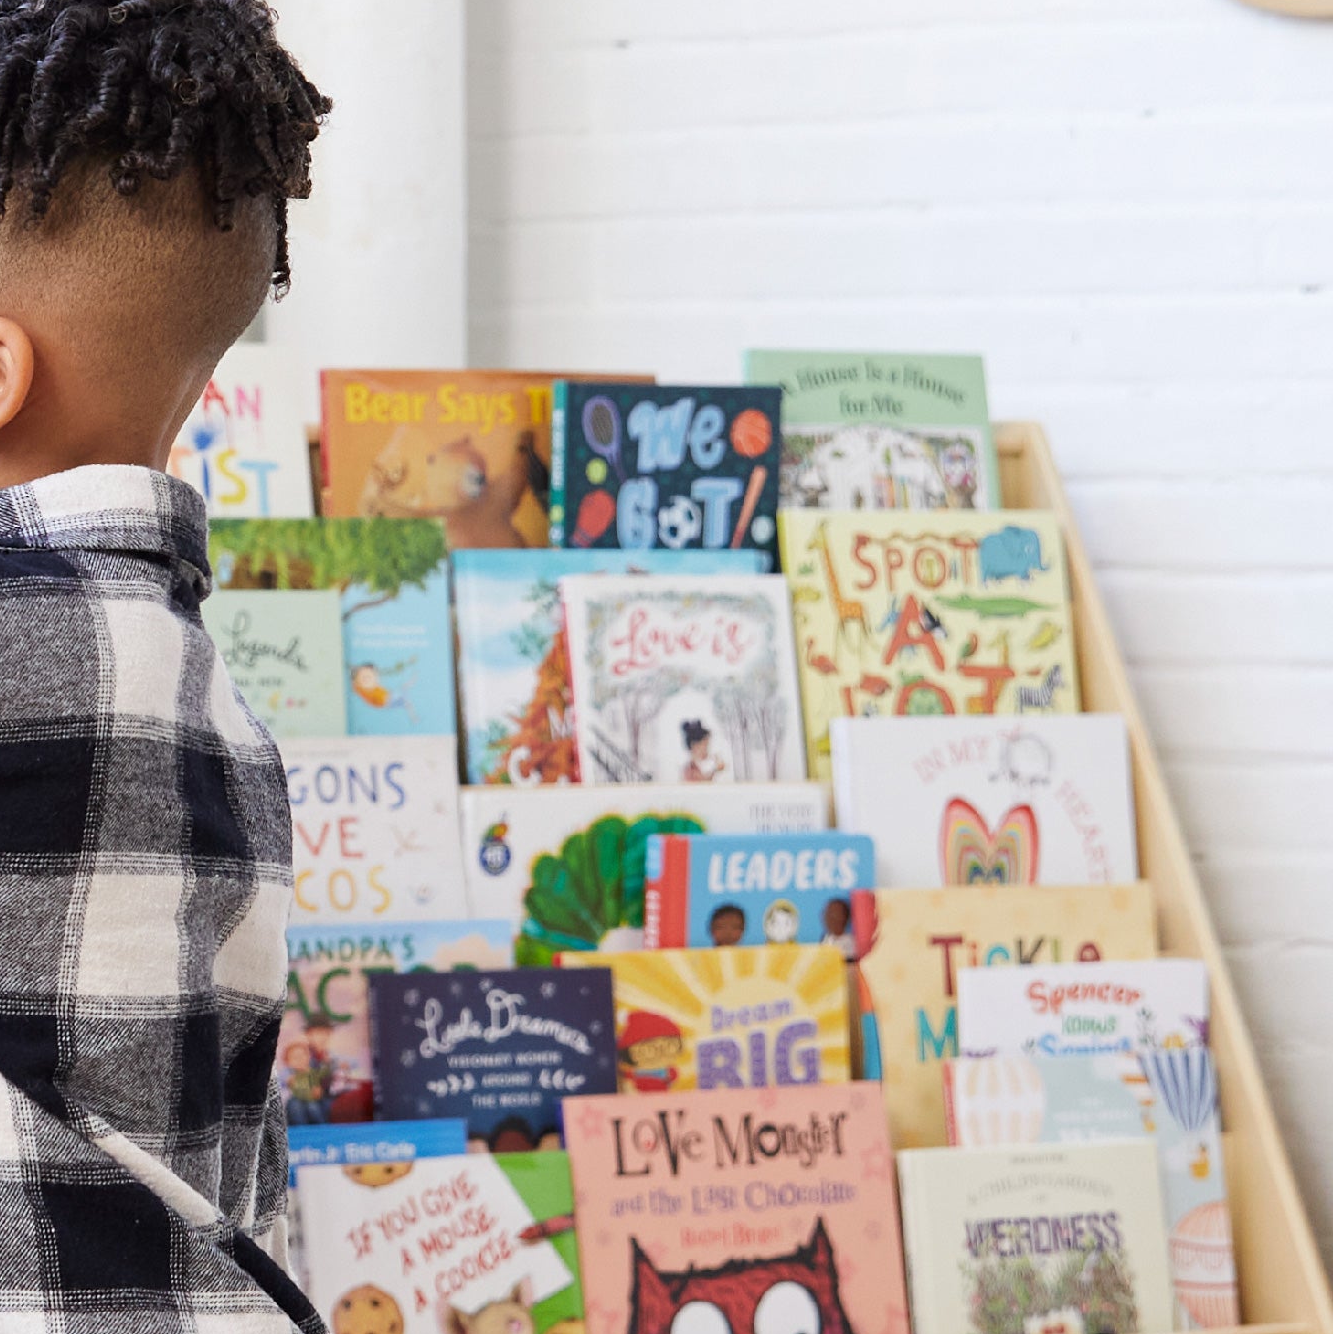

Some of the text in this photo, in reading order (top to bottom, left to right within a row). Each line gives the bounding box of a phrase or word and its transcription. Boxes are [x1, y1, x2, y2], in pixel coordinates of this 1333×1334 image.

[203, 379, 262, 420] AN
[344, 382, 427, 424] Bear
[436, 383, 517, 436] Says
[871, 390, 905, 416] Me
[627, 396, 727, 474] We
[851, 534, 980, 593] SPOT
[610, 607, 757, 676] Love is
[883, 594, 946, 672] A
[296, 816, 365, 860] VE
[294, 864, 393, 915] COS
[707, 849, 858, 894] LEADERS
[710, 999, 791, 1032] Dream
[1026, 980, 1144, 1016] Spencer
[697, 1020, 821, 1090] BIG
[376, 1194, 418, 1241] YOU
[421, 1169, 480, 1217] GIVE
[418, 1203, 498, 1263] MOUSE
[965, 1211, 1123, 1258] WEIRDNESS
